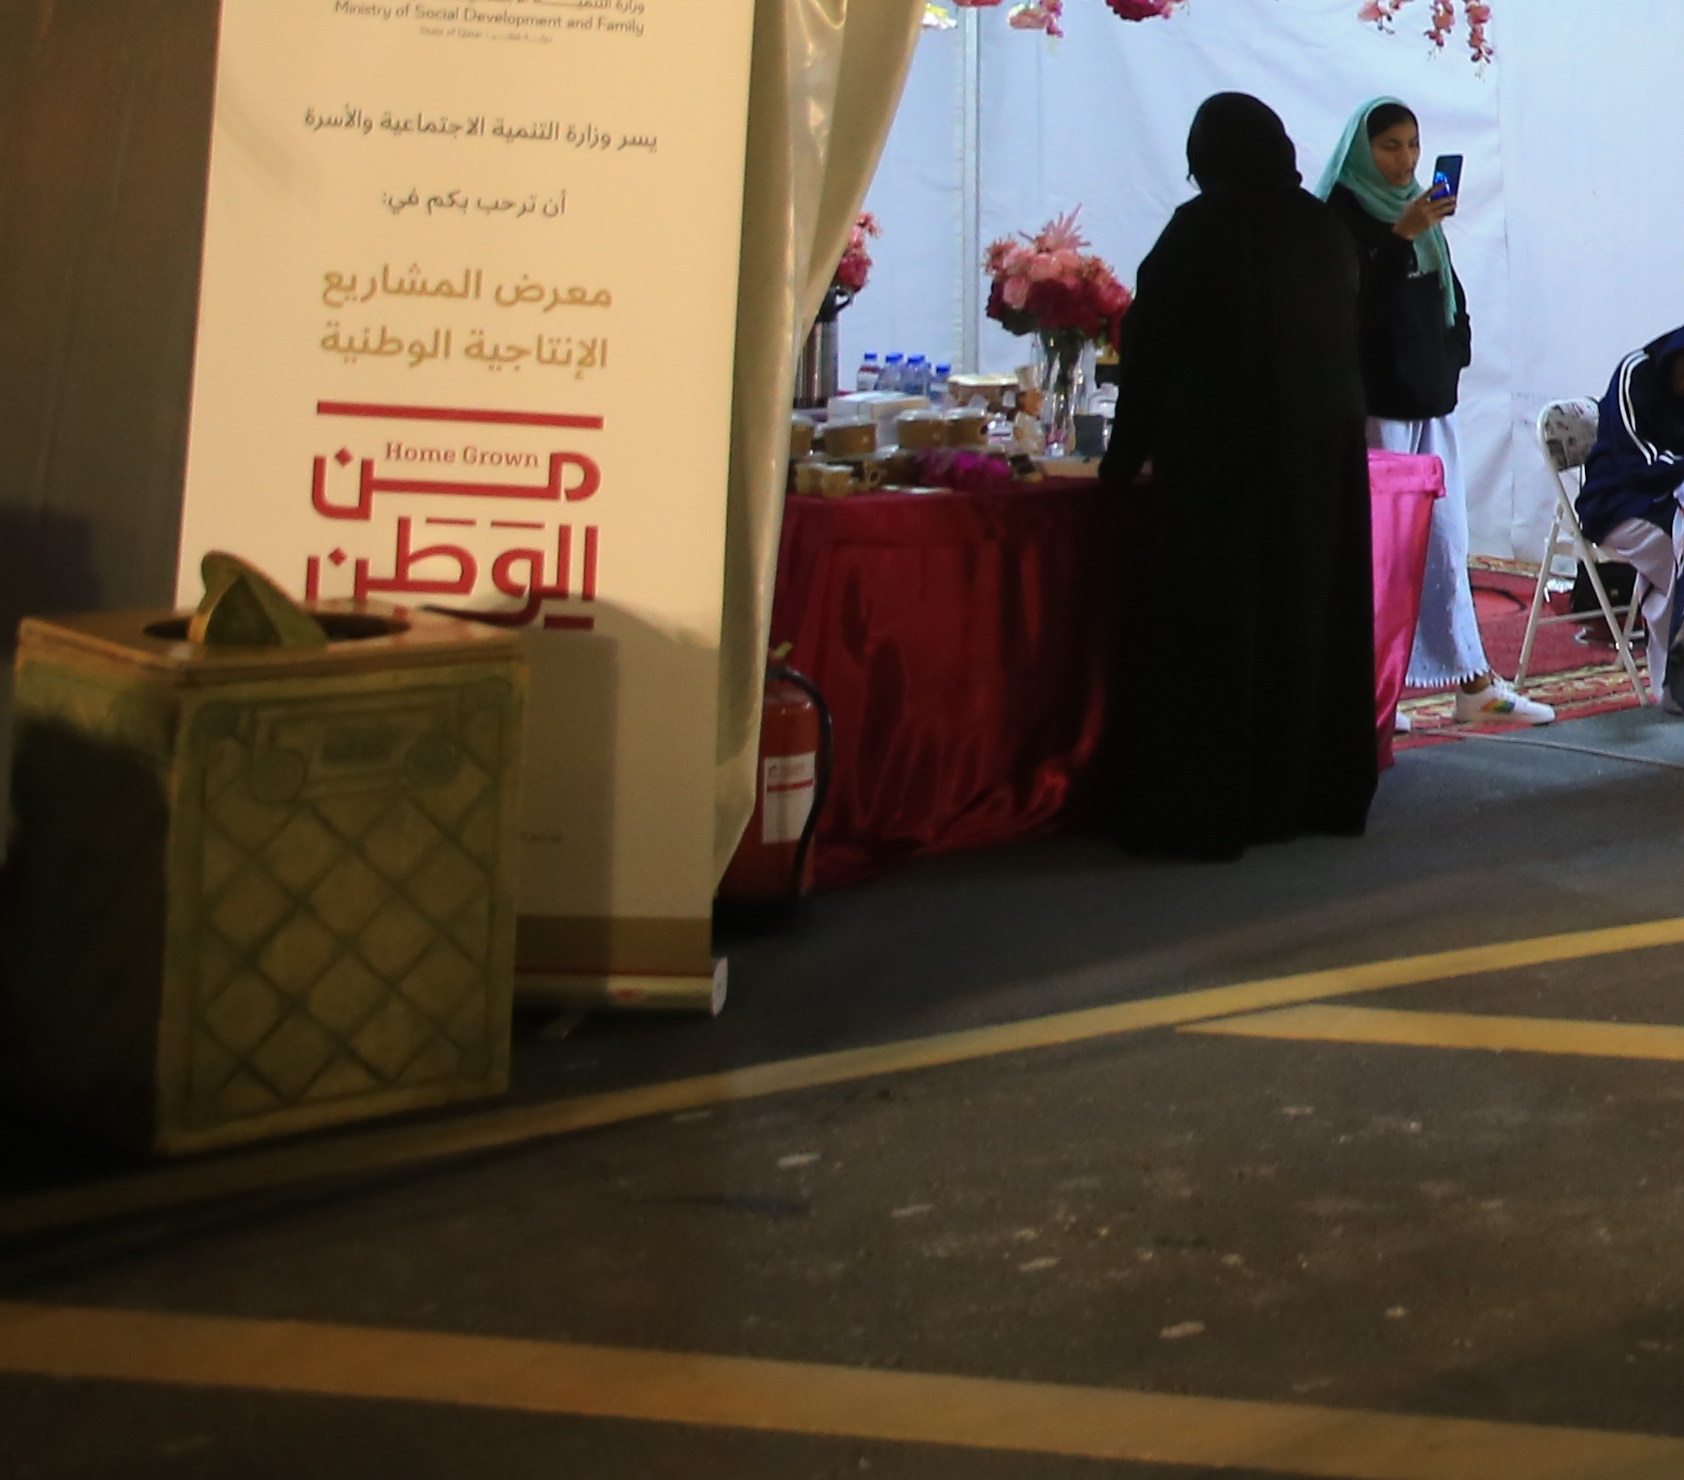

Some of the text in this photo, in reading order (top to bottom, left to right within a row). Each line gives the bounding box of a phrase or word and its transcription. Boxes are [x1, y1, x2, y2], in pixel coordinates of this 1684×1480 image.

[335, 0, 645, 36] Ministry of Social Development and Family
[304, 103, 658, 152] يسر وزارة التنمية الاجتماعية والأسرة
[427, 190, 470, 215] بكم
[542, 189, 567, 218] أن
[321, 262, 612, 313] معرض المشاريع
[319, 322, 608, 380] الإنتاجية الوطنية
[384, 441, 540, 469] Home Grown
[310, 445, 601, 520] من
